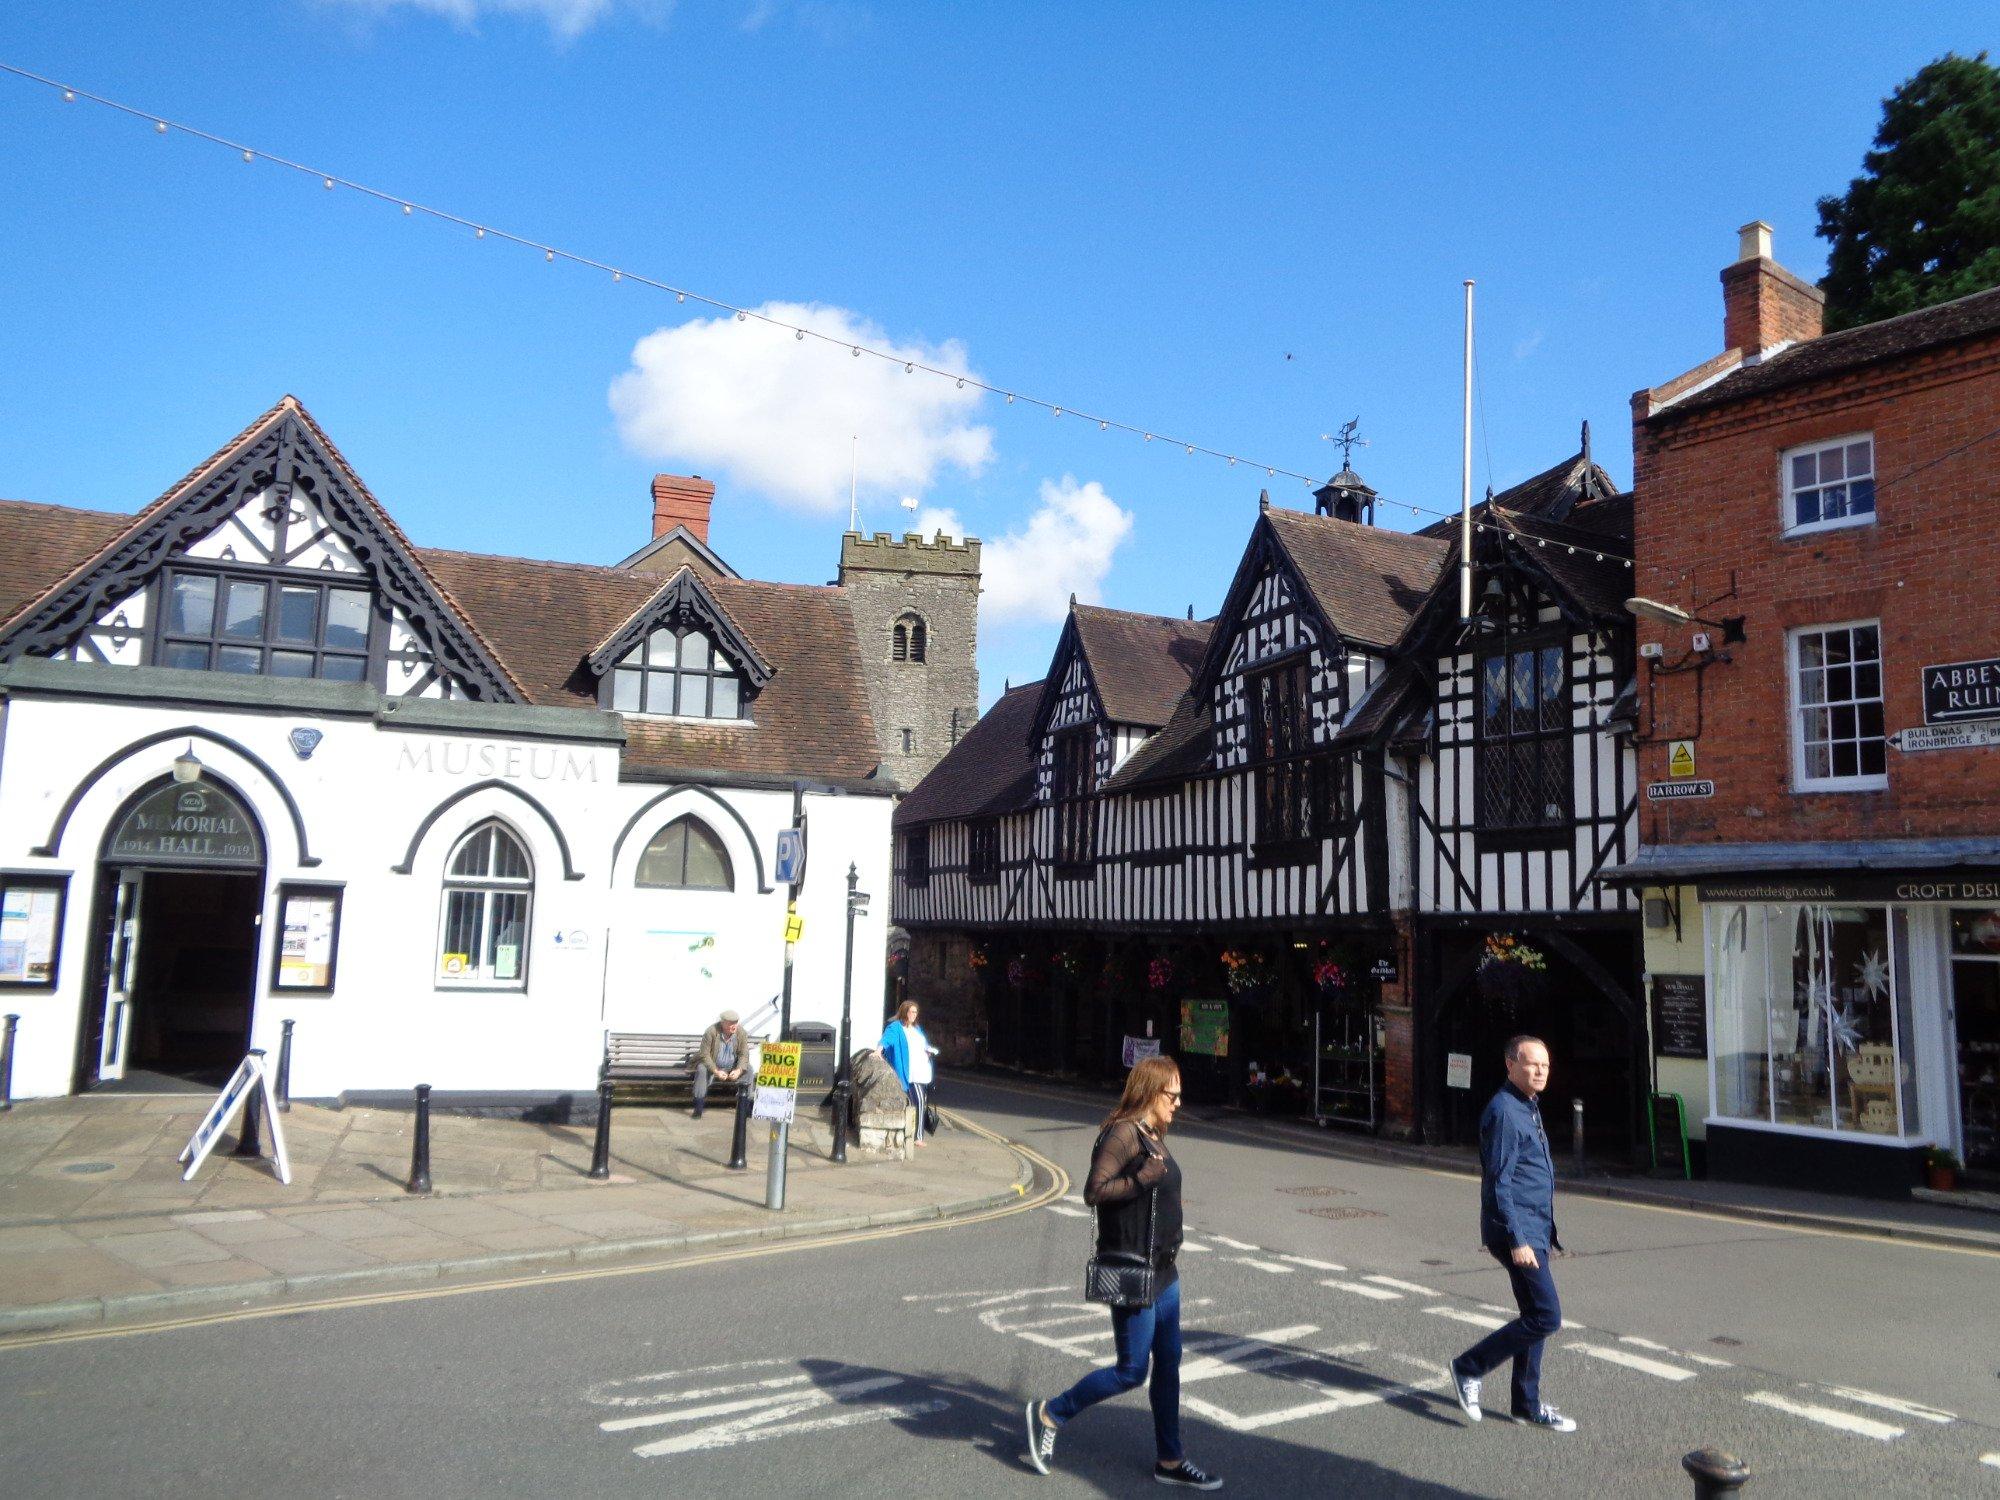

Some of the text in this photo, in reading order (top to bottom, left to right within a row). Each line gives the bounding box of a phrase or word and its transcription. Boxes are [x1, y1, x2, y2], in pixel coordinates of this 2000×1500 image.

[1908, 727, 1962, 739] BUILDWAS
[1908, 734, 1973, 748] IRONBRIDGE
[396, 741, 599, 783] MUSEUM
[1650, 784, 1697, 797] BARROW
[159, 836, 215, 855] HALL
[778, 836, 790, 877] P
[1706, 886, 1836, 899] www.croftdesign.co.uk
[1897, 883, 2000, 898] CROFT DESI
[785, 918, 802, 939] H
[762, 1043, 798, 1054] PERSIAN
[763, 1053, 795, 1067] RUG
[760, 1064, 797, 1076] CLEARANCE
[757, 1075, 796, 1089] SALE
